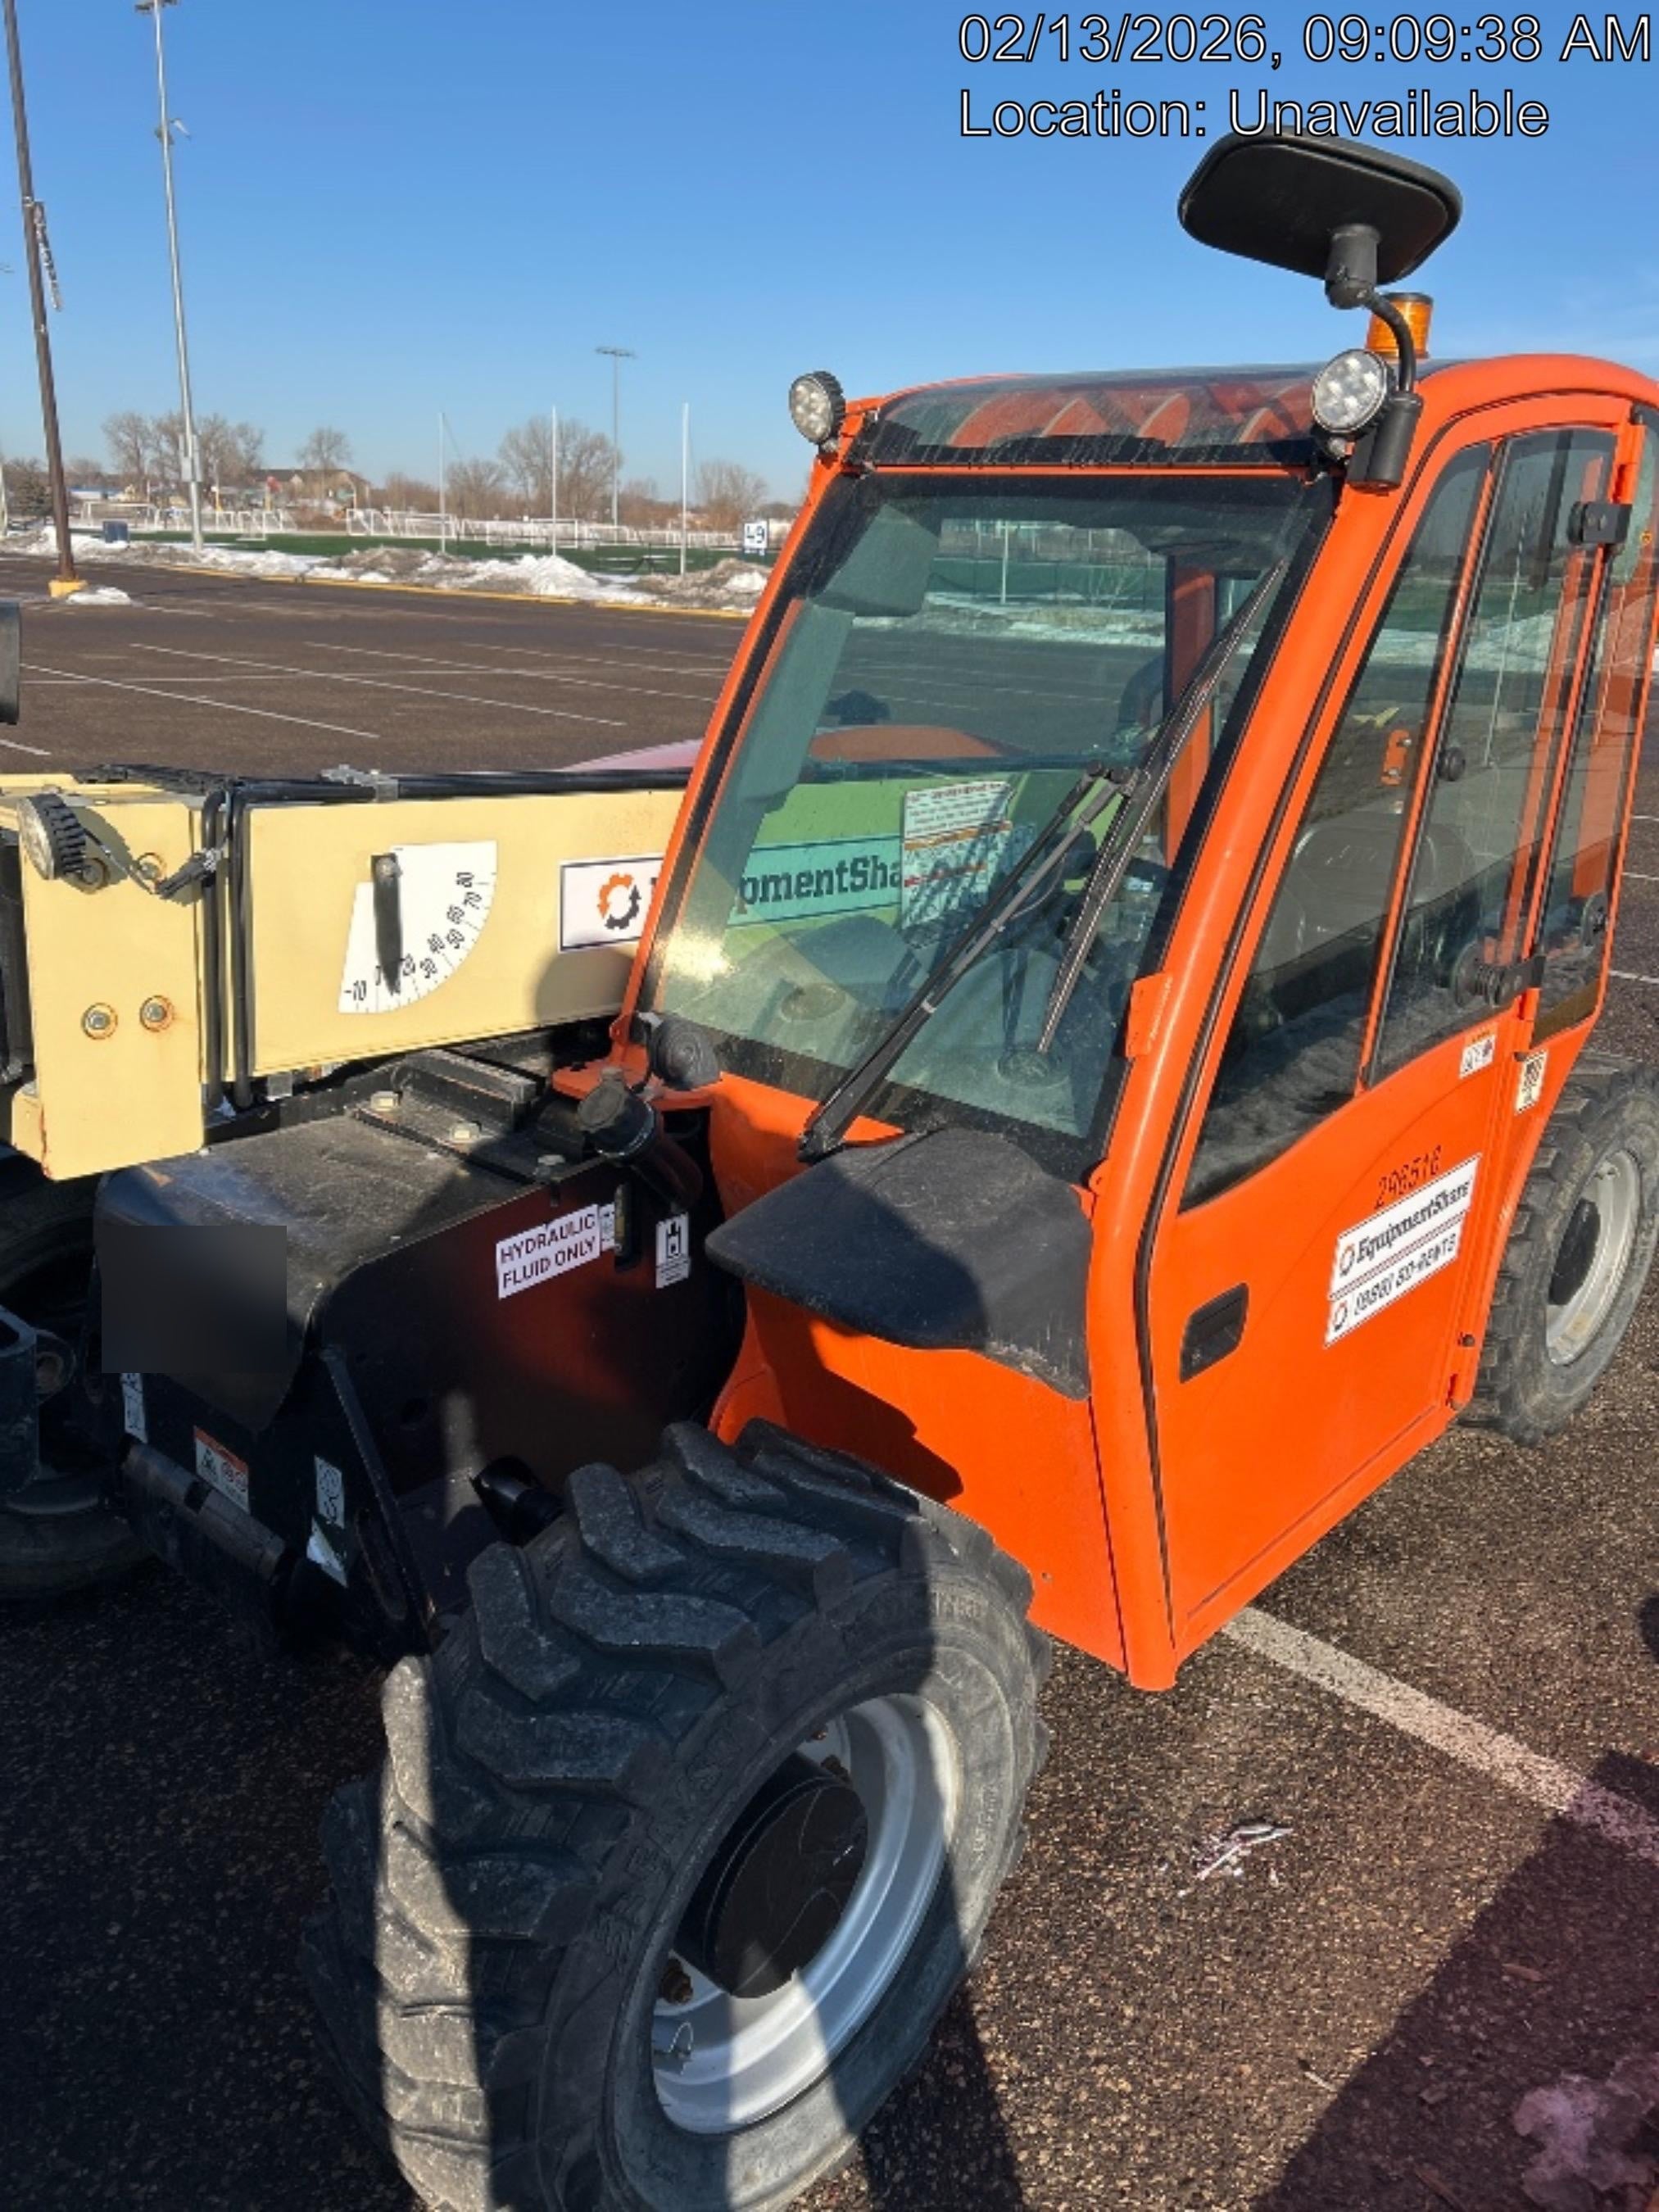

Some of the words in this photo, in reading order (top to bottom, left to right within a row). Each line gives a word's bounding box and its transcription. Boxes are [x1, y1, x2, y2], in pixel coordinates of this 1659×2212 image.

[463, 891, 483, 909] 70
[446, 928, 465, 950] 50
[418, 957, 437, 979] 30
[500, 1213, 596, 1264] HYDRAULIC
[1357, 1180, 1471, 1263] EquipmentShare
[502, 1257, 551, 1290] FLUID
[555, 1235, 596, 1267] ONLY
